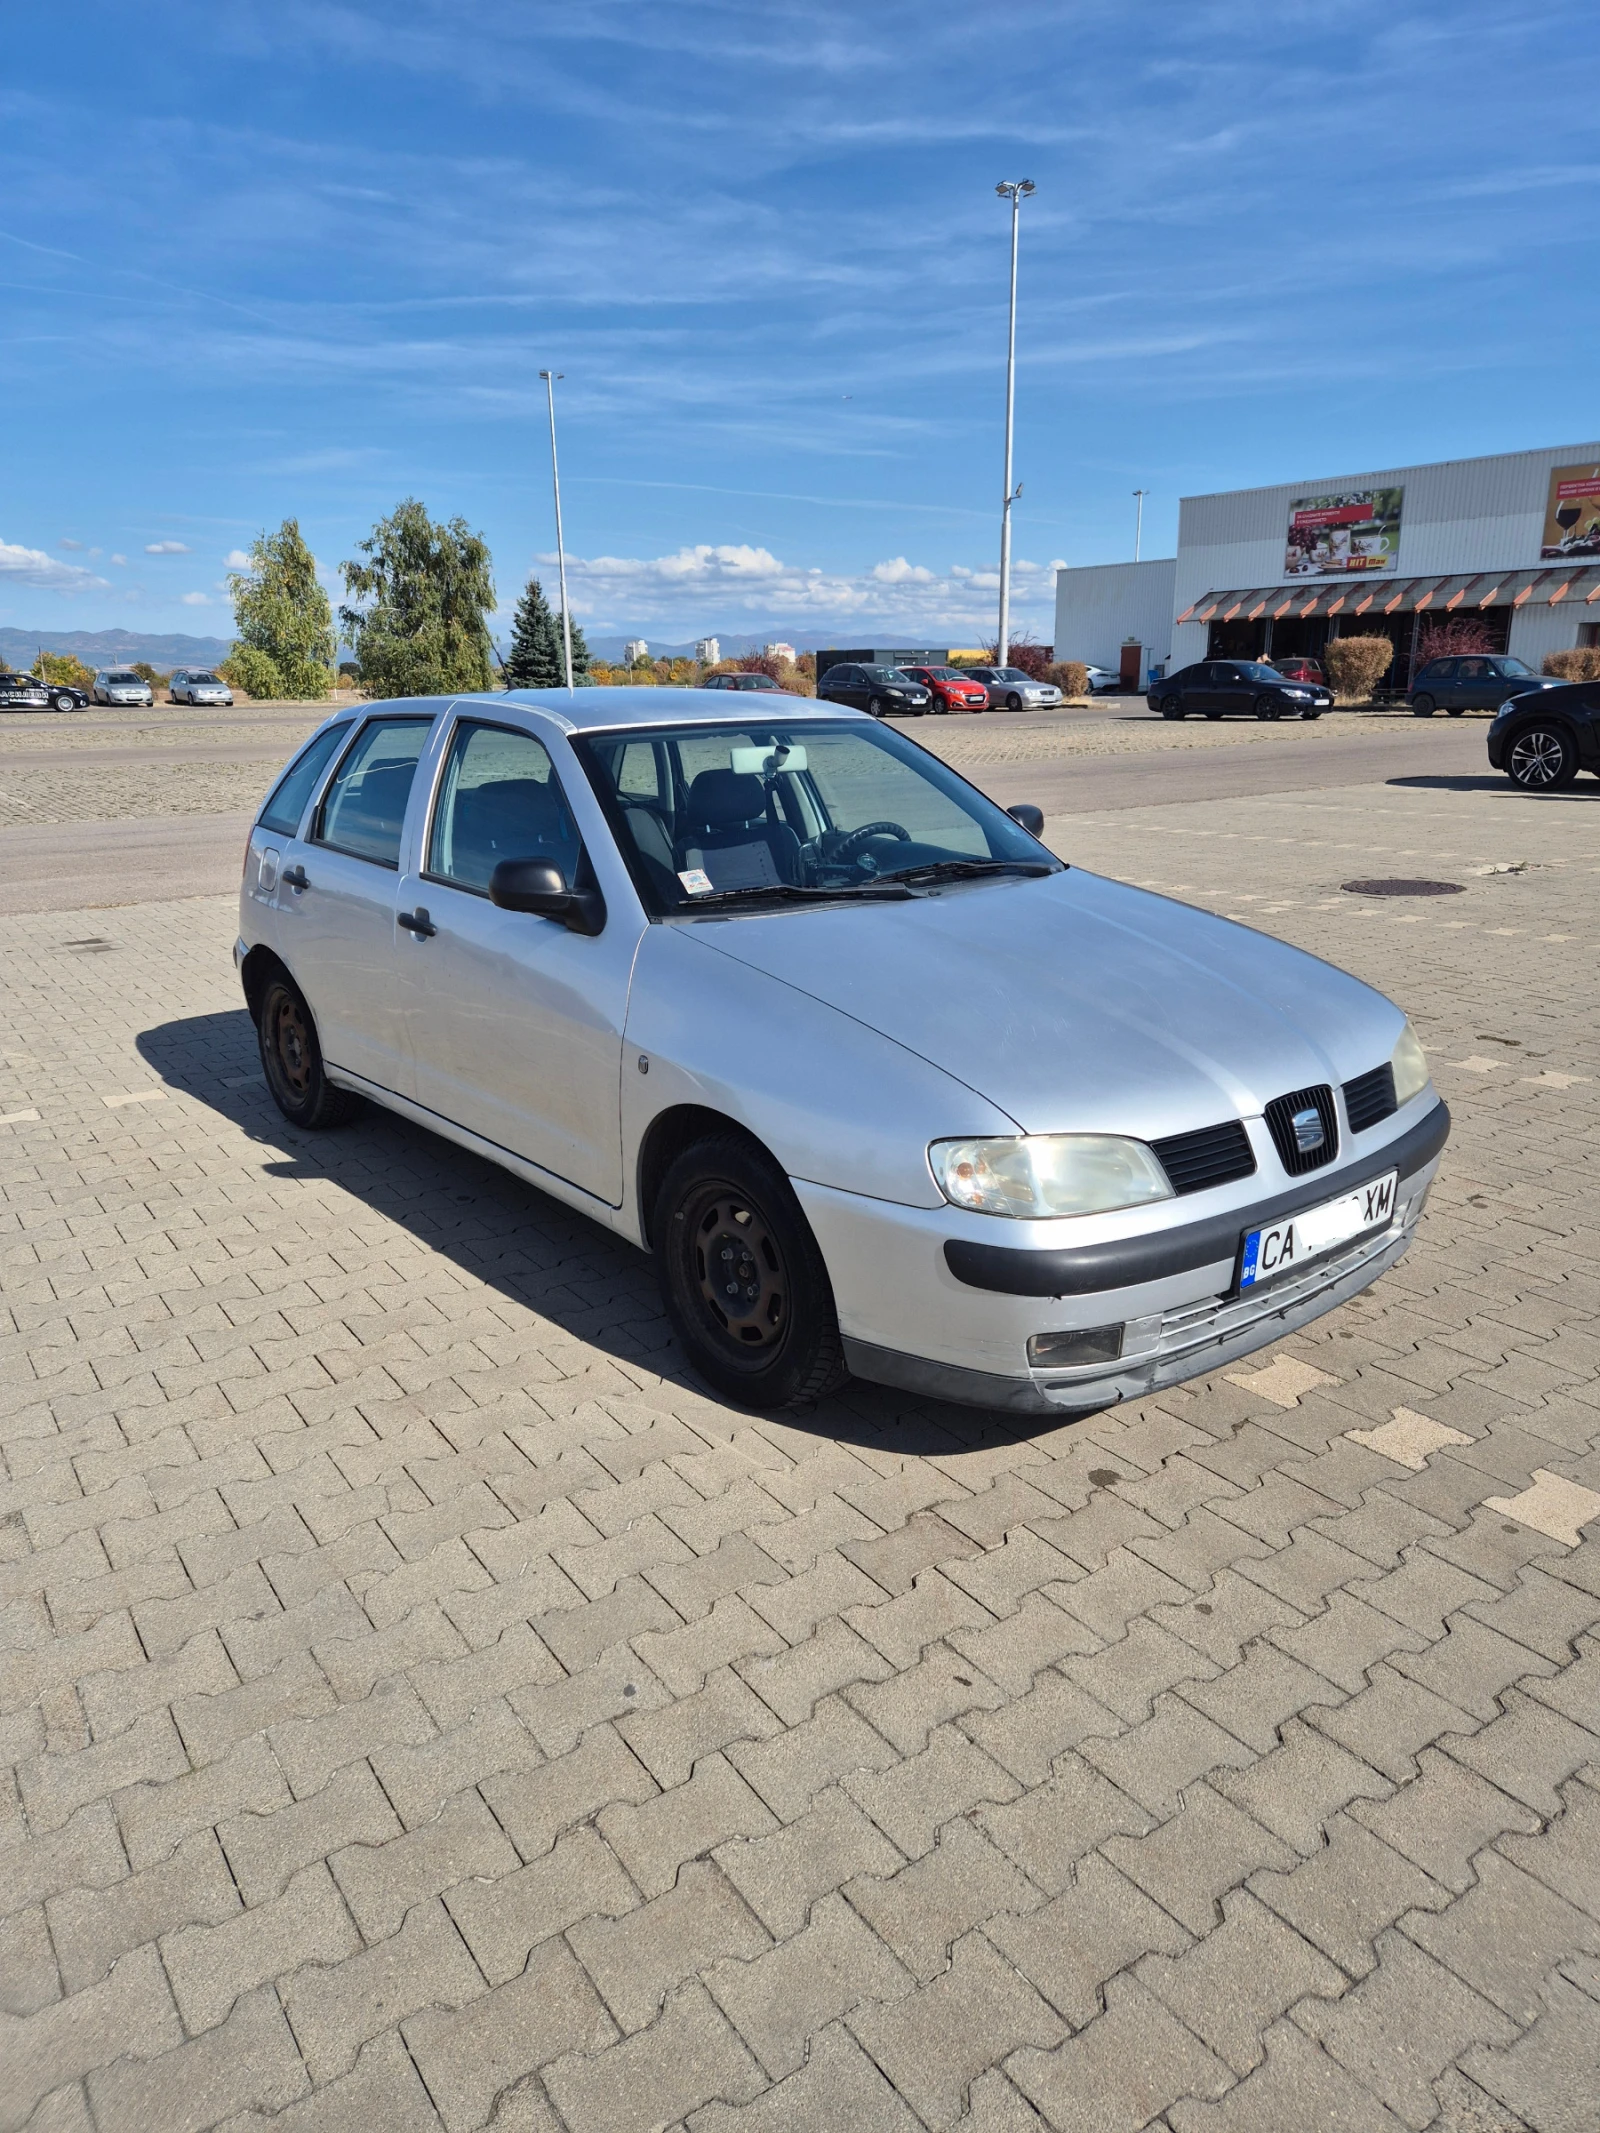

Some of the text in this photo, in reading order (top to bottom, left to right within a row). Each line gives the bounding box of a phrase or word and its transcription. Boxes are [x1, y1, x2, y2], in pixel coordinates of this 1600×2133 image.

[1349, 558, 1366, 567] HIT
[1262, 1178, 1393, 1270] CA XM
[1243, 1264, 1256, 1279] BG
